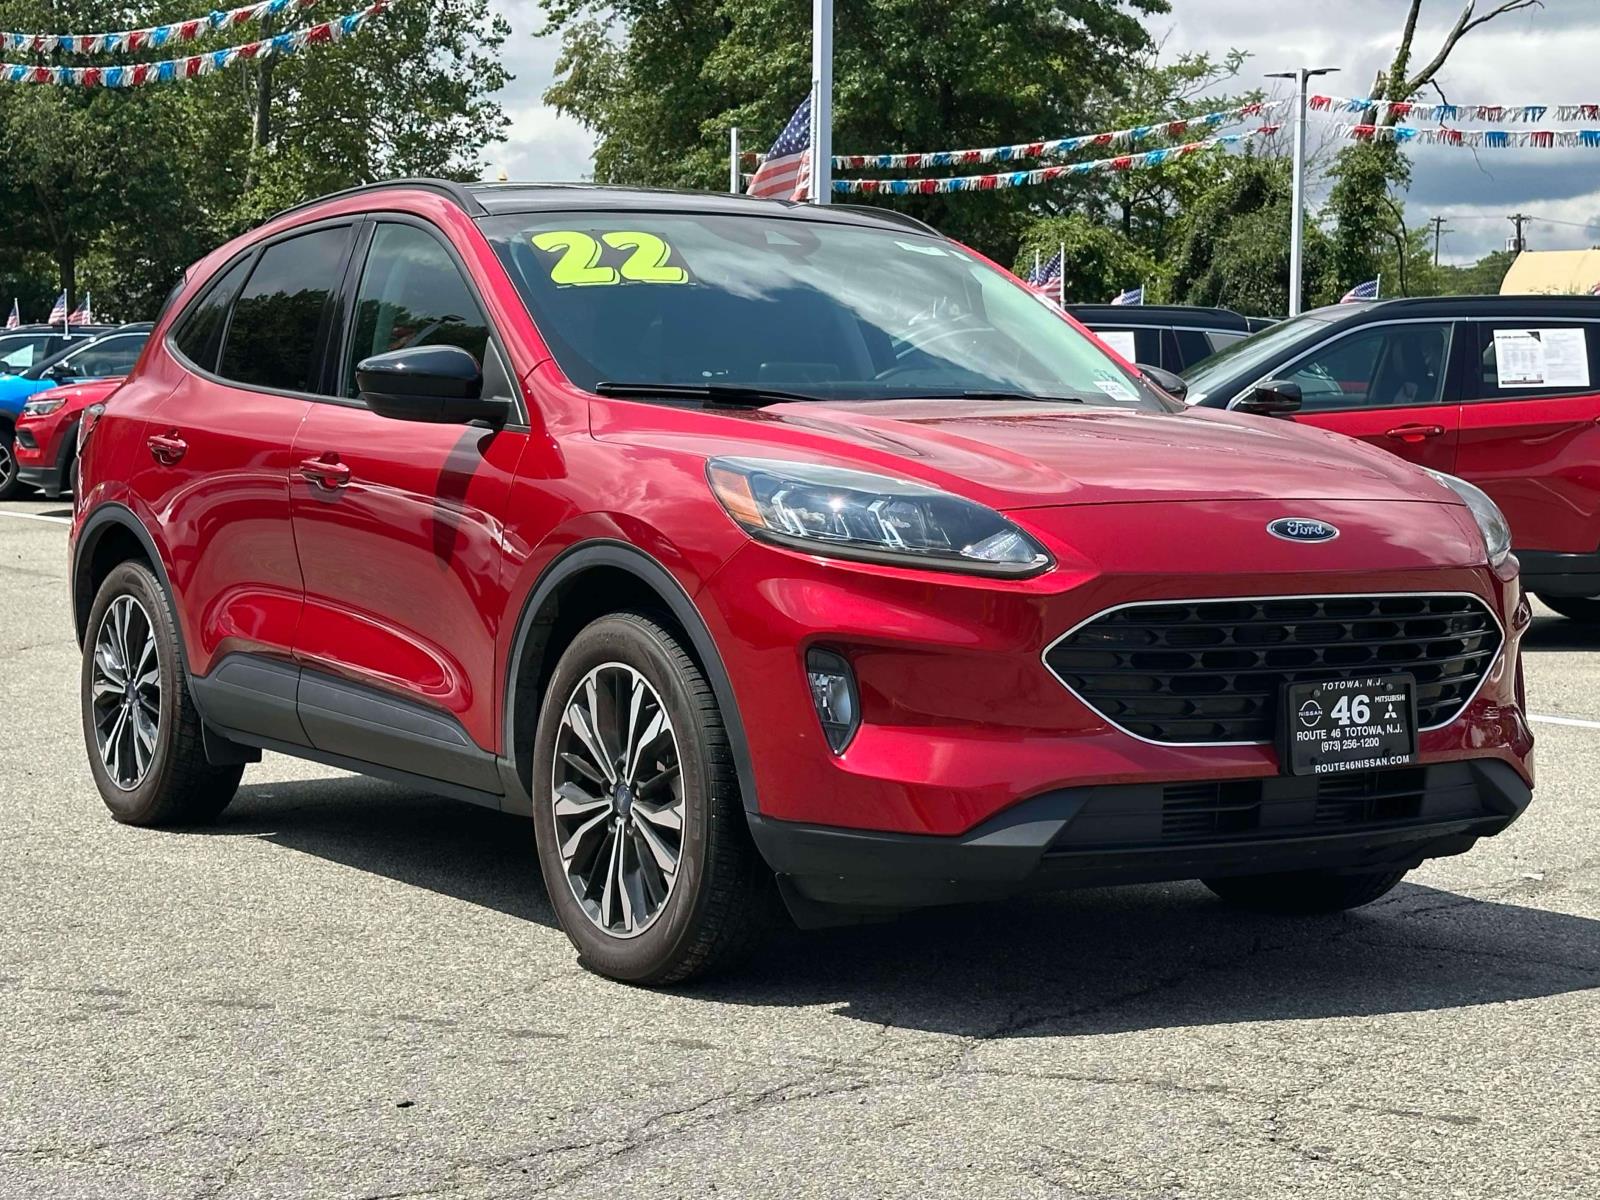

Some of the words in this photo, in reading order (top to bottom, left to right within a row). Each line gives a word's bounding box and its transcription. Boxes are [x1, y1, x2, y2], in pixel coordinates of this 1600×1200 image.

[532, 231, 688, 286] 22
[1287, 521, 1325, 535] Ford
[1366, 678, 1384, 687] N.J.
[1374, 694, 1405, 703] MITSUBISHI
[1330, 694, 1370, 725] 46
[1296, 729, 1327, 741] ROUTE
[1330, 728, 1341, 738] 46
[1386, 724, 1403, 734] N.J.
[1321, 740, 1340, 753] (973)
[1342, 737, 1379, 750] 256-1200
